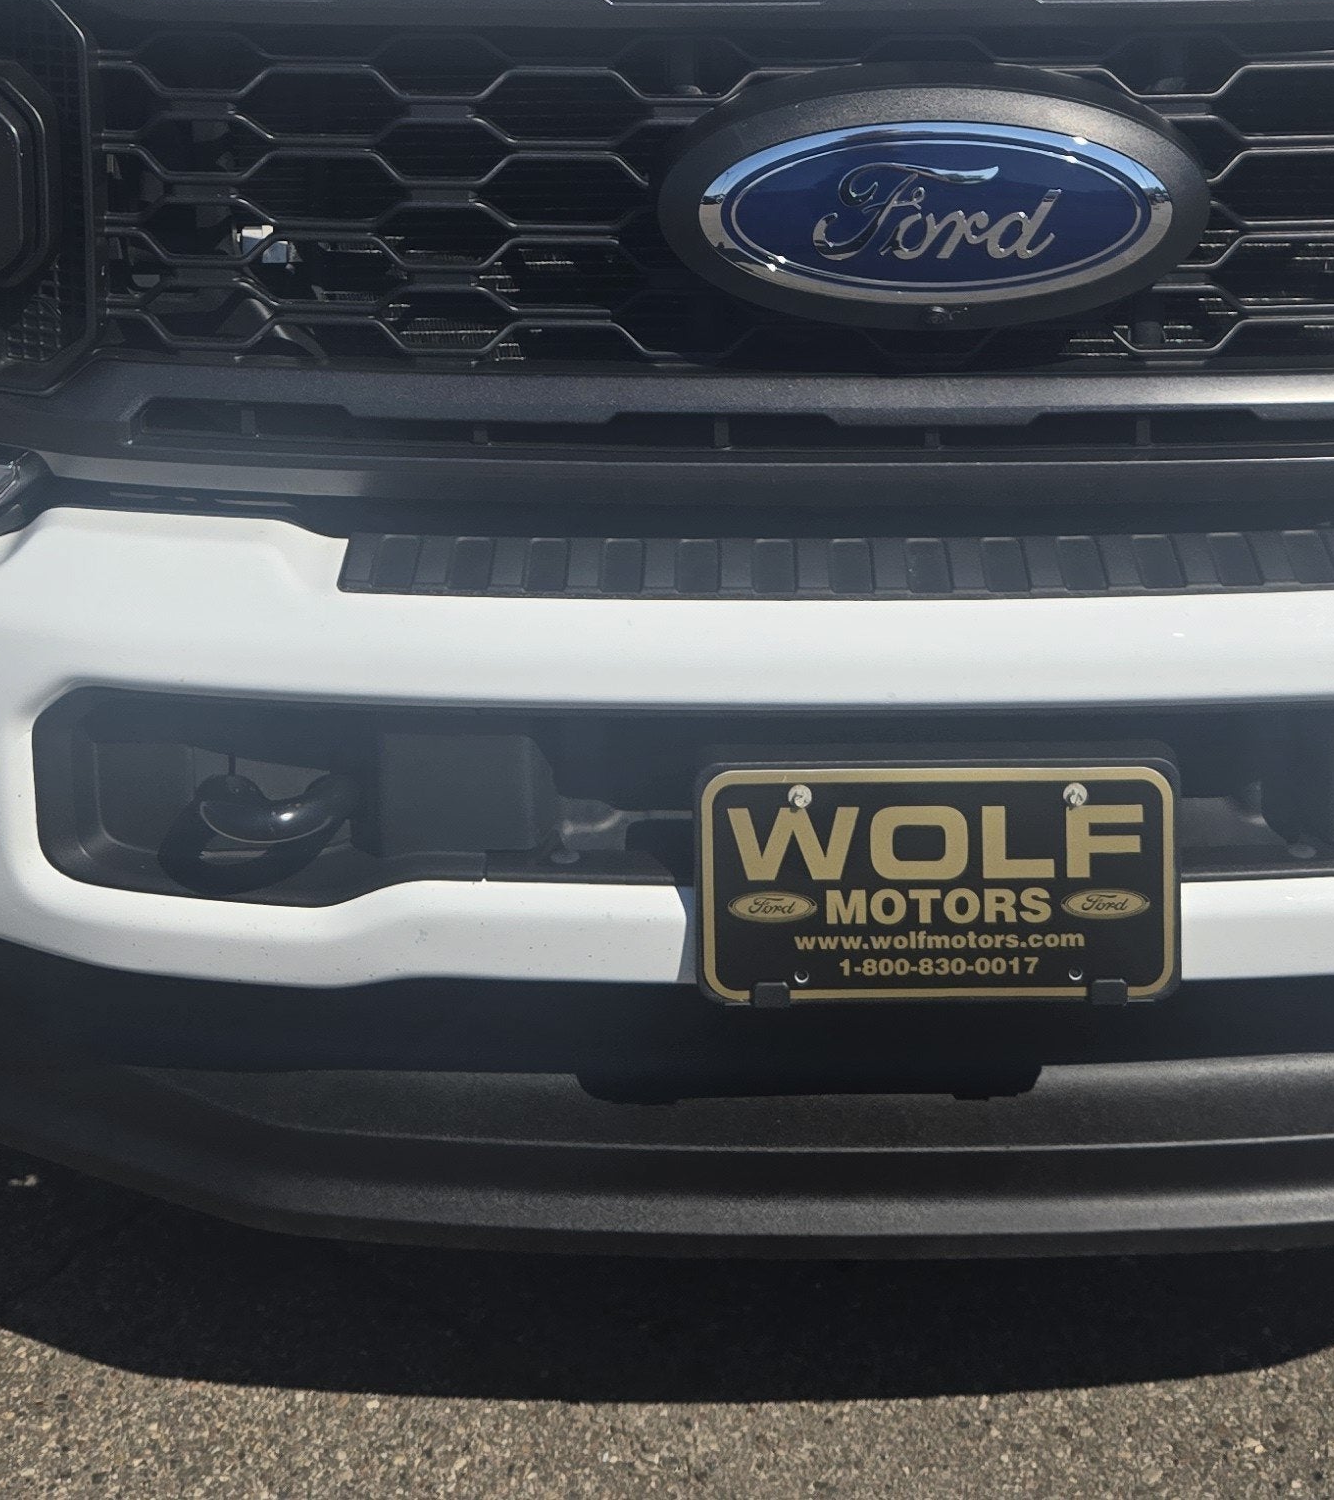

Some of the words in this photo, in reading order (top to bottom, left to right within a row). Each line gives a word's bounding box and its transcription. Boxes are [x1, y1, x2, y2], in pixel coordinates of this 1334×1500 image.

[812, 161, 1061, 261] Ford
[727, 804, 1144, 882] WOLF
[748, 896, 797, 915] Ford
[825, 887, 1053, 925] MOTORS
[1081, 894, 1128, 912] Ford
[794, 930, 1085, 950] www.wolfmotors.com
[839, 957, 1040, 976] 1-800-830-0017
